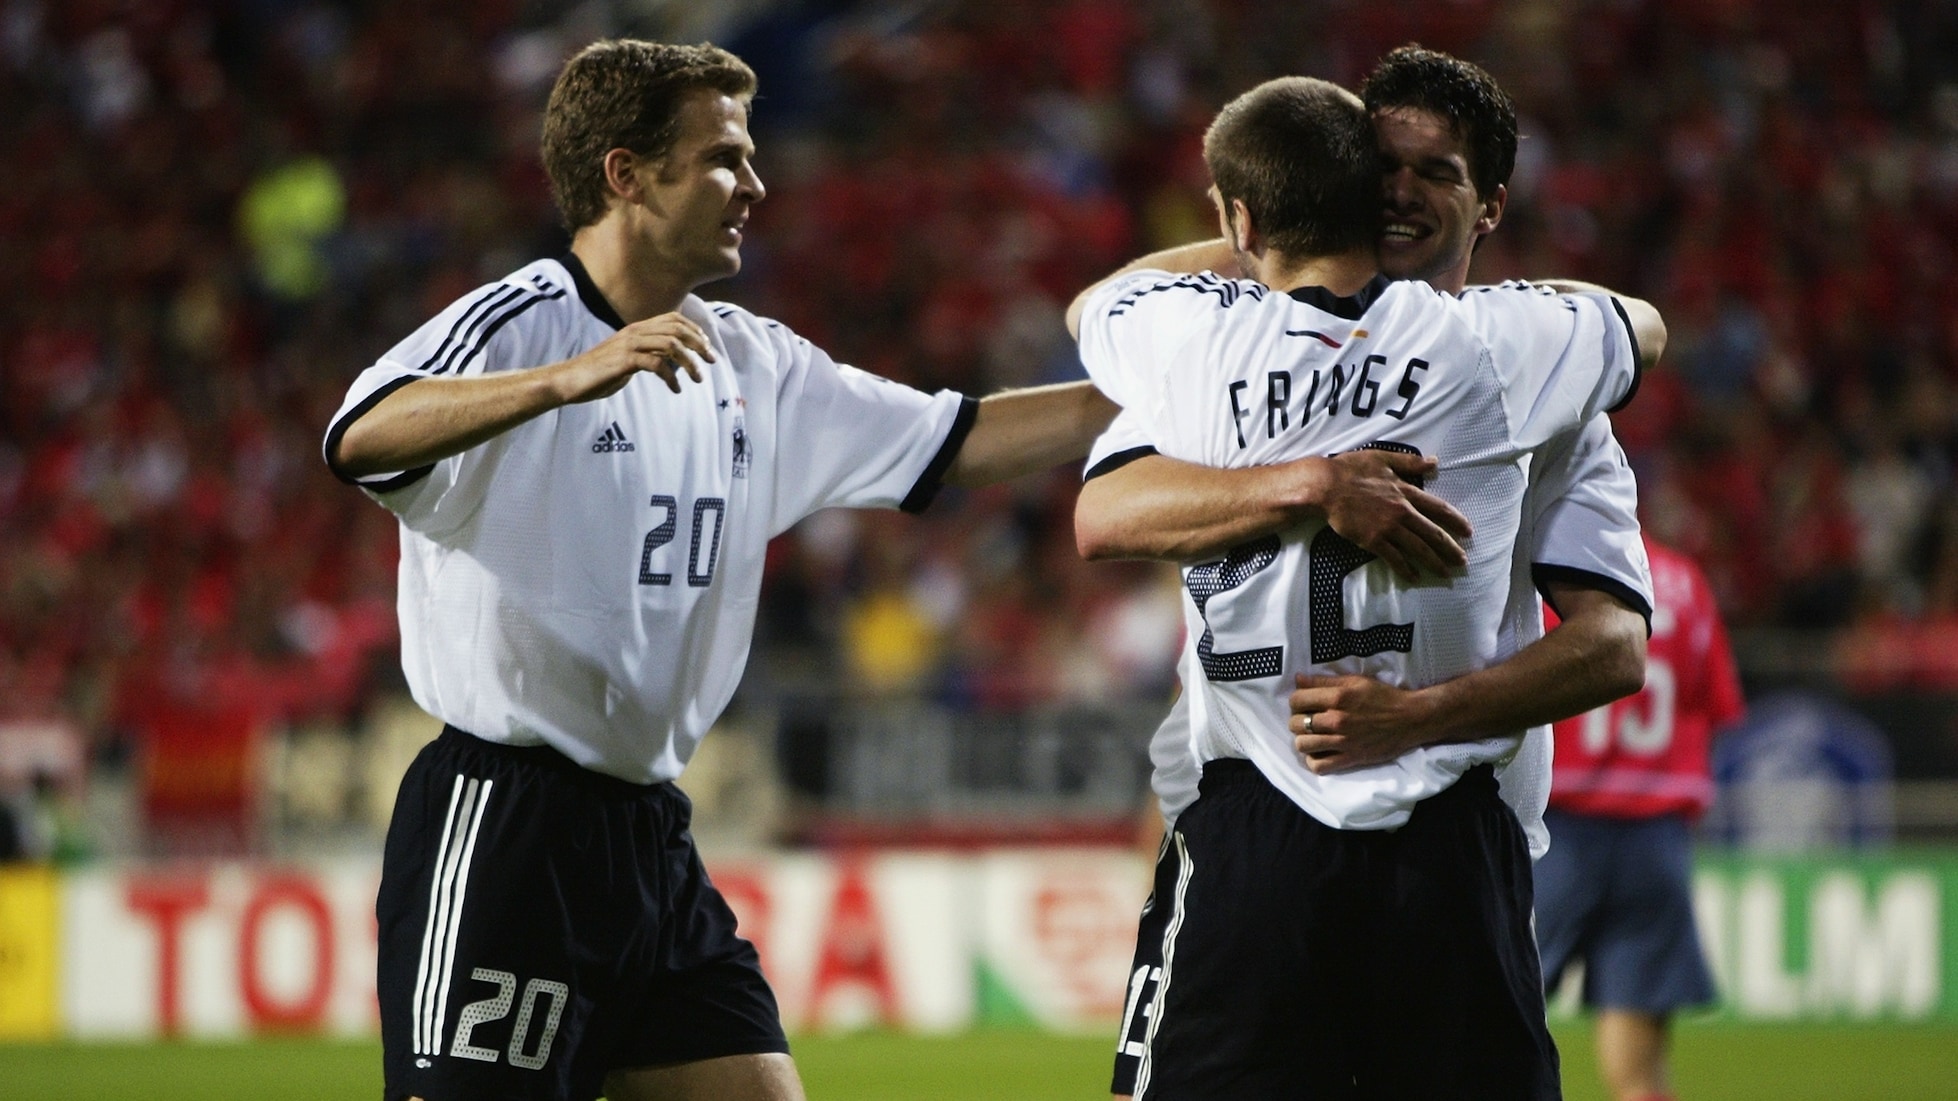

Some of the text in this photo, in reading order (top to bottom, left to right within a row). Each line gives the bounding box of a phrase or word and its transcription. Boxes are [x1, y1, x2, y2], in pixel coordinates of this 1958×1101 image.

[592, 438, 636, 454] adidas
[1228, 354, 1430, 450] FRINGS
[638, 494, 726, 588] 20
[450, 967, 569, 1071] 20
